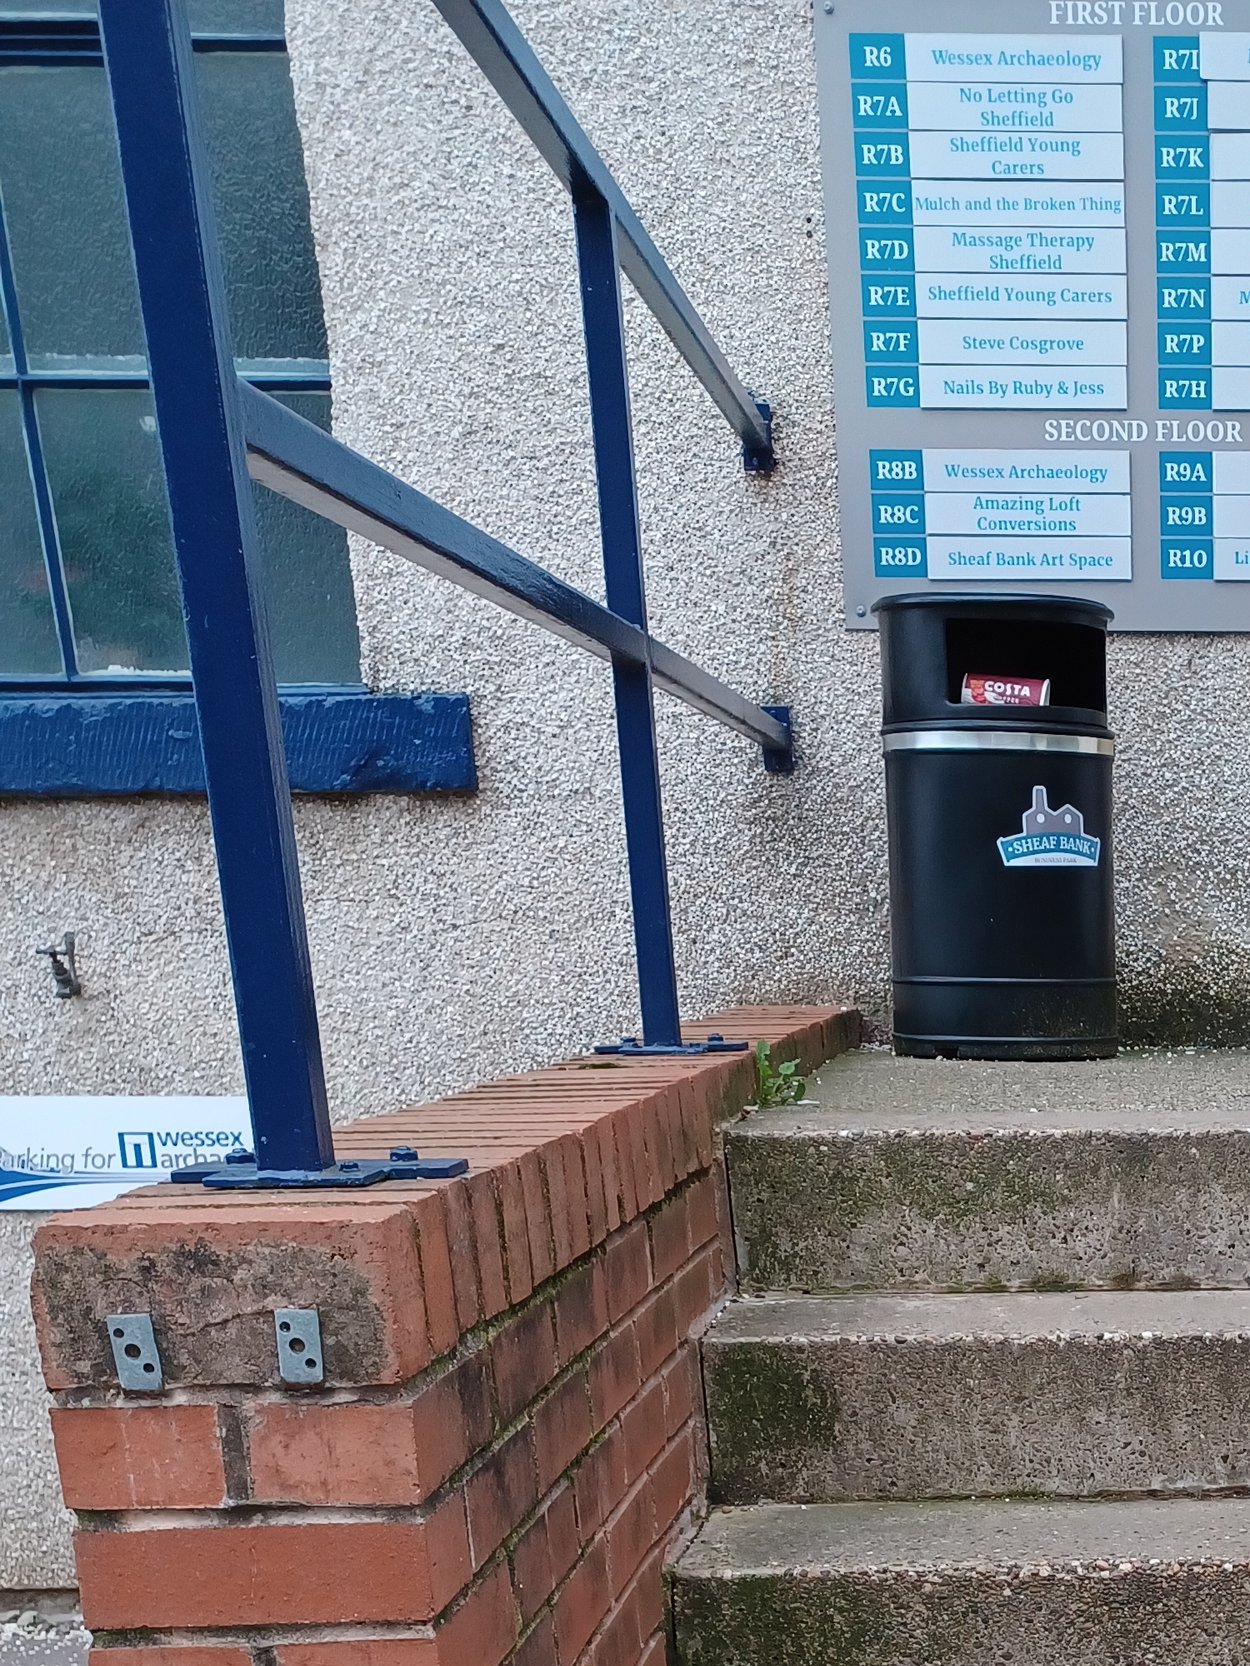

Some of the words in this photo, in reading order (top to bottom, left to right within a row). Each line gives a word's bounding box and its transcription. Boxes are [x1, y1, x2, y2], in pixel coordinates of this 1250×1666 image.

[1049, 1, 1125, 25] FIRST
[1132, 2, 1224, 26] FLOOR
[863, 46, 892, 67] R6
[931, 50, 993, 65] Wessex
[997, 51, 1101, 71] Archaeology
[857, 95, 903, 116] R7A
[959, 88, 982, 103] No
[987, 89, 1047, 107] Letting
[1051, 89, 1073, 104] Go
[1164, 98, 1199, 120] R7J
[980, 111, 1054, 127] Sheffield
[861, 144, 904, 165] R7B
[950, 137, 1023, 152] Sheffield
[1028, 138, 1081, 156] Young
[1160, 148, 1204, 167] R7K
[991, 161, 1045, 175] Carers
[863, 193, 906, 212] R7C
[915, 197, 960, 211] Mulch
[964, 197, 992, 211] and
[996, 198, 1019, 211] the
[1023, 198, 1076, 211] Broken
[1080, 197, 1121, 214] Thing
[1162, 195, 1204, 215] R7L
[865, 240, 909, 259] R7D
[952, 232, 1022, 251] Massage
[1027, 233, 1095, 251] Therapy
[1159, 242, 1208, 262] R7M
[989, 255, 1062, 270] Sheffield
[868, 286, 910, 306] R7E
[928, 286, 999, 301] Sheffield
[1004, 288, 1056, 306] Young
[1060, 289, 1113, 303] Carers
[1162, 289, 1206, 308] R7N
[870, 332, 911, 352] R7F
[962, 336, 1005, 350] Steve
[1009, 337, 1084, 354] Cosgrove
[1164, 334, 1205, 353] R7P
[871, 378, 915, 397] R7G
[943, 380, 984, 394] Nails
[988, 381, 1008, 398] By
[1013, 381, 1052, 398] Ruby
[1057, 381, 1069, 395] &
[1073, 381, 1104, 397] Jess
[1164, 380, 1207, 398] R7H
[1044, 419, 1149, 442] SECOND
[1155, 420, 1243, 443] FLOOR
[876, 461, 918, 480] R8B
[944, 464, 1005, 478] Wessex
[1008, 465, 1108, 483] Archaeology
[1164, 463, 1208, 482] R9A
[878, 505, 919, 524] R8C
[973, 496, 1044, 515] Amazing
[1049, 497, 1081, 511] Loft
[977, 516, 1076, 531] Conversions
[1166, 507, 1207, 526] R9B
[879, 548, 921, 566] R8D
[948, 552, 992, 566] Sheaf
[996, 552, 1035, 566] Bank
[1040, 553, 1065, 566] Art
[1069, 553, 1113, 570] Space
[985, 681, 1030, 697] COSTA
[1013, 836, 1057, 854] SHEAF
[1060, 836, 1090, 854] BANK
[157, 1130, 244, 1147] wessex
[0, 1147, 75, 1174] arking
[82, 1147, 116, 1168] for
